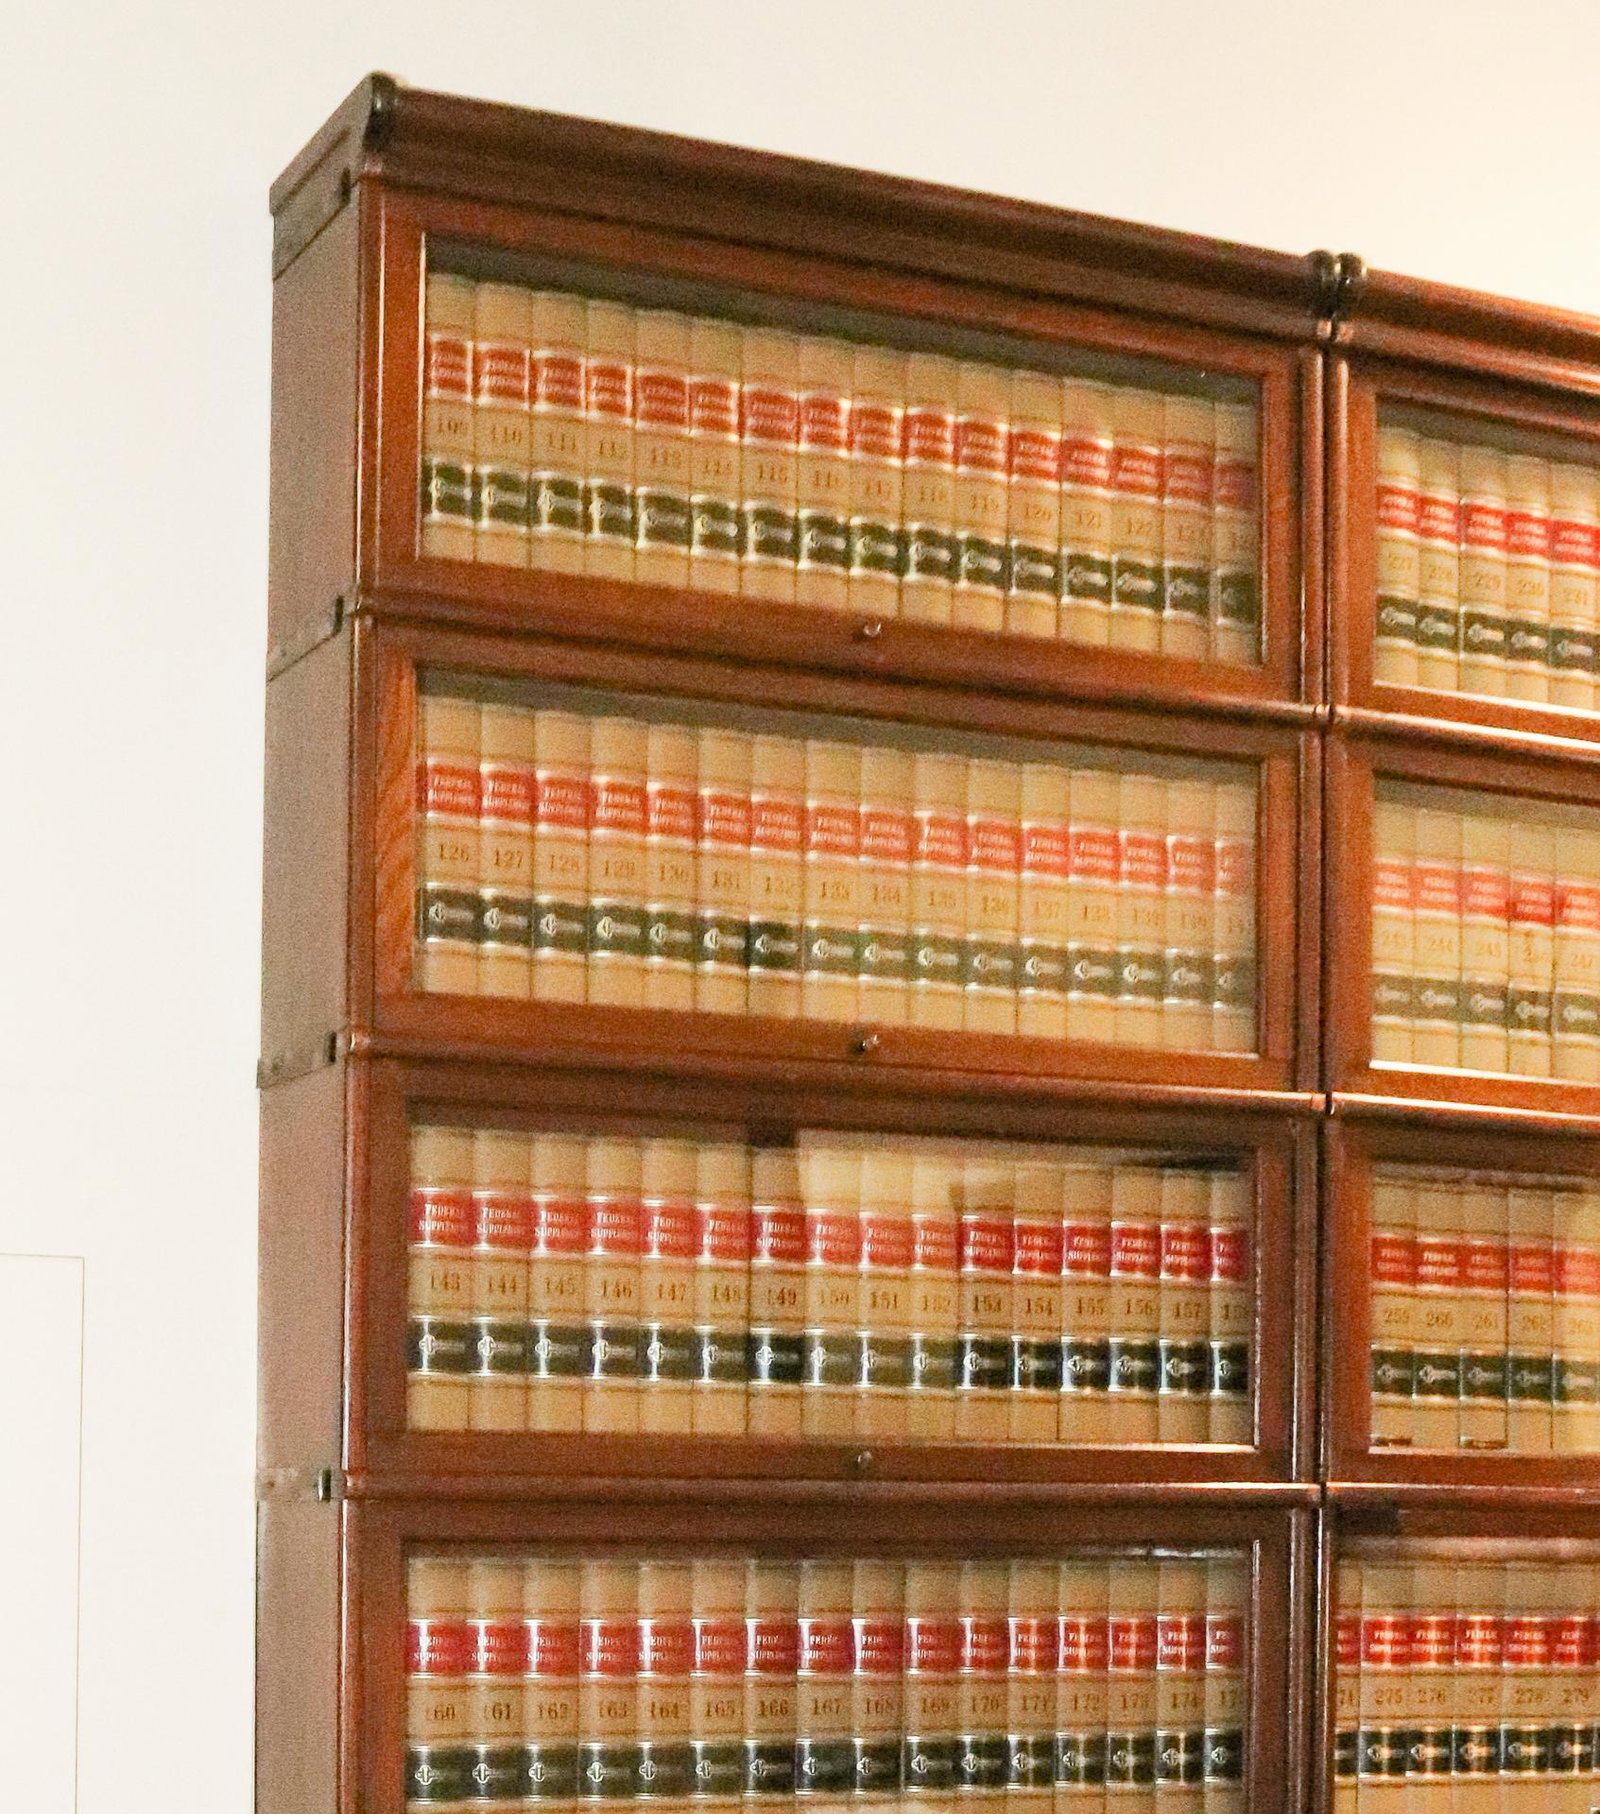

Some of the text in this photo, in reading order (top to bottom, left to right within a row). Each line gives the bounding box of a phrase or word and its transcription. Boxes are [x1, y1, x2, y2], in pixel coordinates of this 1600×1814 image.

[493, 848, 523, 869] 127
[419, 1220, 468, 1233] SUPPL
[477, 1223, 525, 1237] SUPPL
[535, 1226, 580, 1240] SUPPL
[591, 1228, 637, 1241] SUPPL
[648, 1231, 691, 1245] SUPPL
[756, 1237, 801, 1250] SUPPL
[964, 1245, 1007, 1257] SUPPL
[1068, 1251, 1106, 1263] SUPPL
[1113, 1252, 1156, 1264] SUPPL
[488, 1274, 517, 1295] 144
[546, 1274, 576, 1296] 145
[602, 1278, 633, 1299] 146
[658, 1282, 687, 1303] 147
[768, 1286, 798, 1306] 149
[1025, 1298, 1054, 1317] 154
[650, 1701, 680, 1720] 164
[705, 1700, 735, 1718] 165
[758, 1700, 789, 1718] 166
[812, 1699, 841, 1716] 167
[864, 1698, 893, 1715] 168
[971, 1696, 1000, 1713] 170
